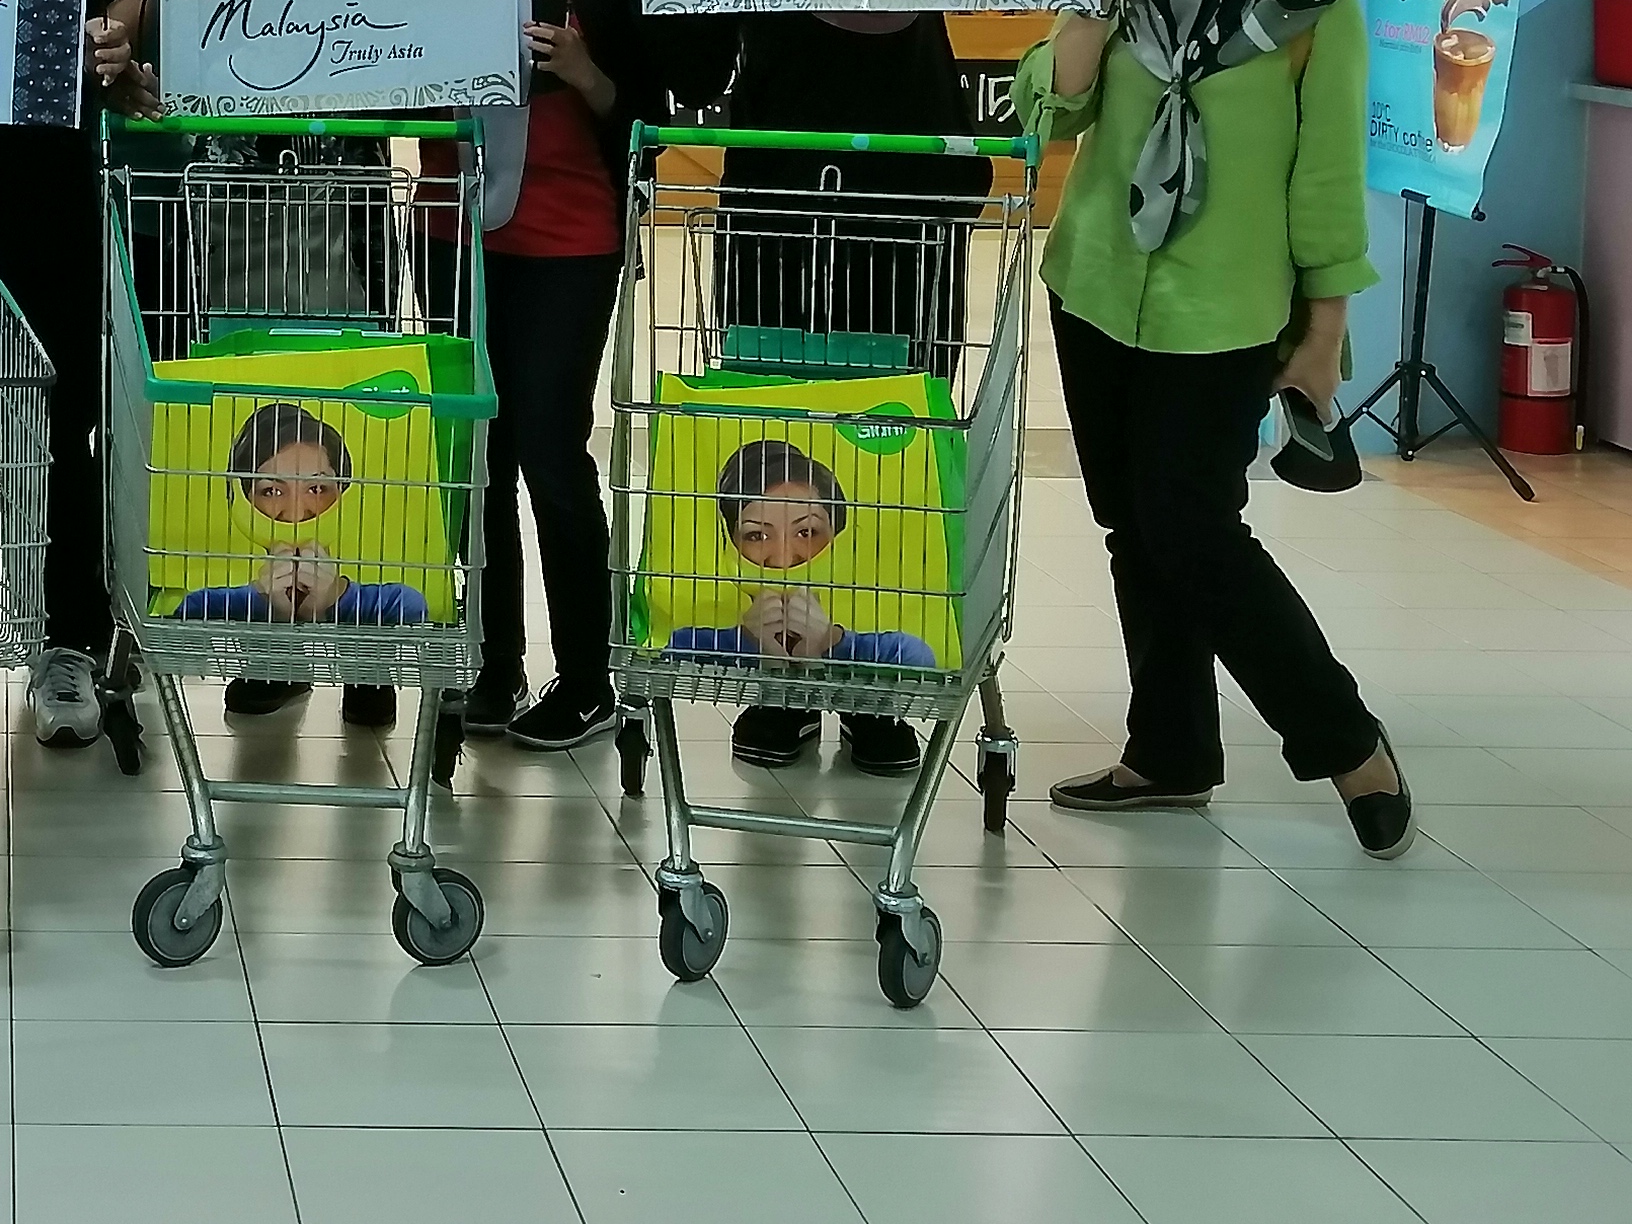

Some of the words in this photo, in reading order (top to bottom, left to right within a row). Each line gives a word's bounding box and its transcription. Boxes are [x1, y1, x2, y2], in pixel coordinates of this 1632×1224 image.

[329, 39, 384, 64] Truly
[386, 43, 425, 61] Asia
[1370, 119, 1400, 143] DIRTY
